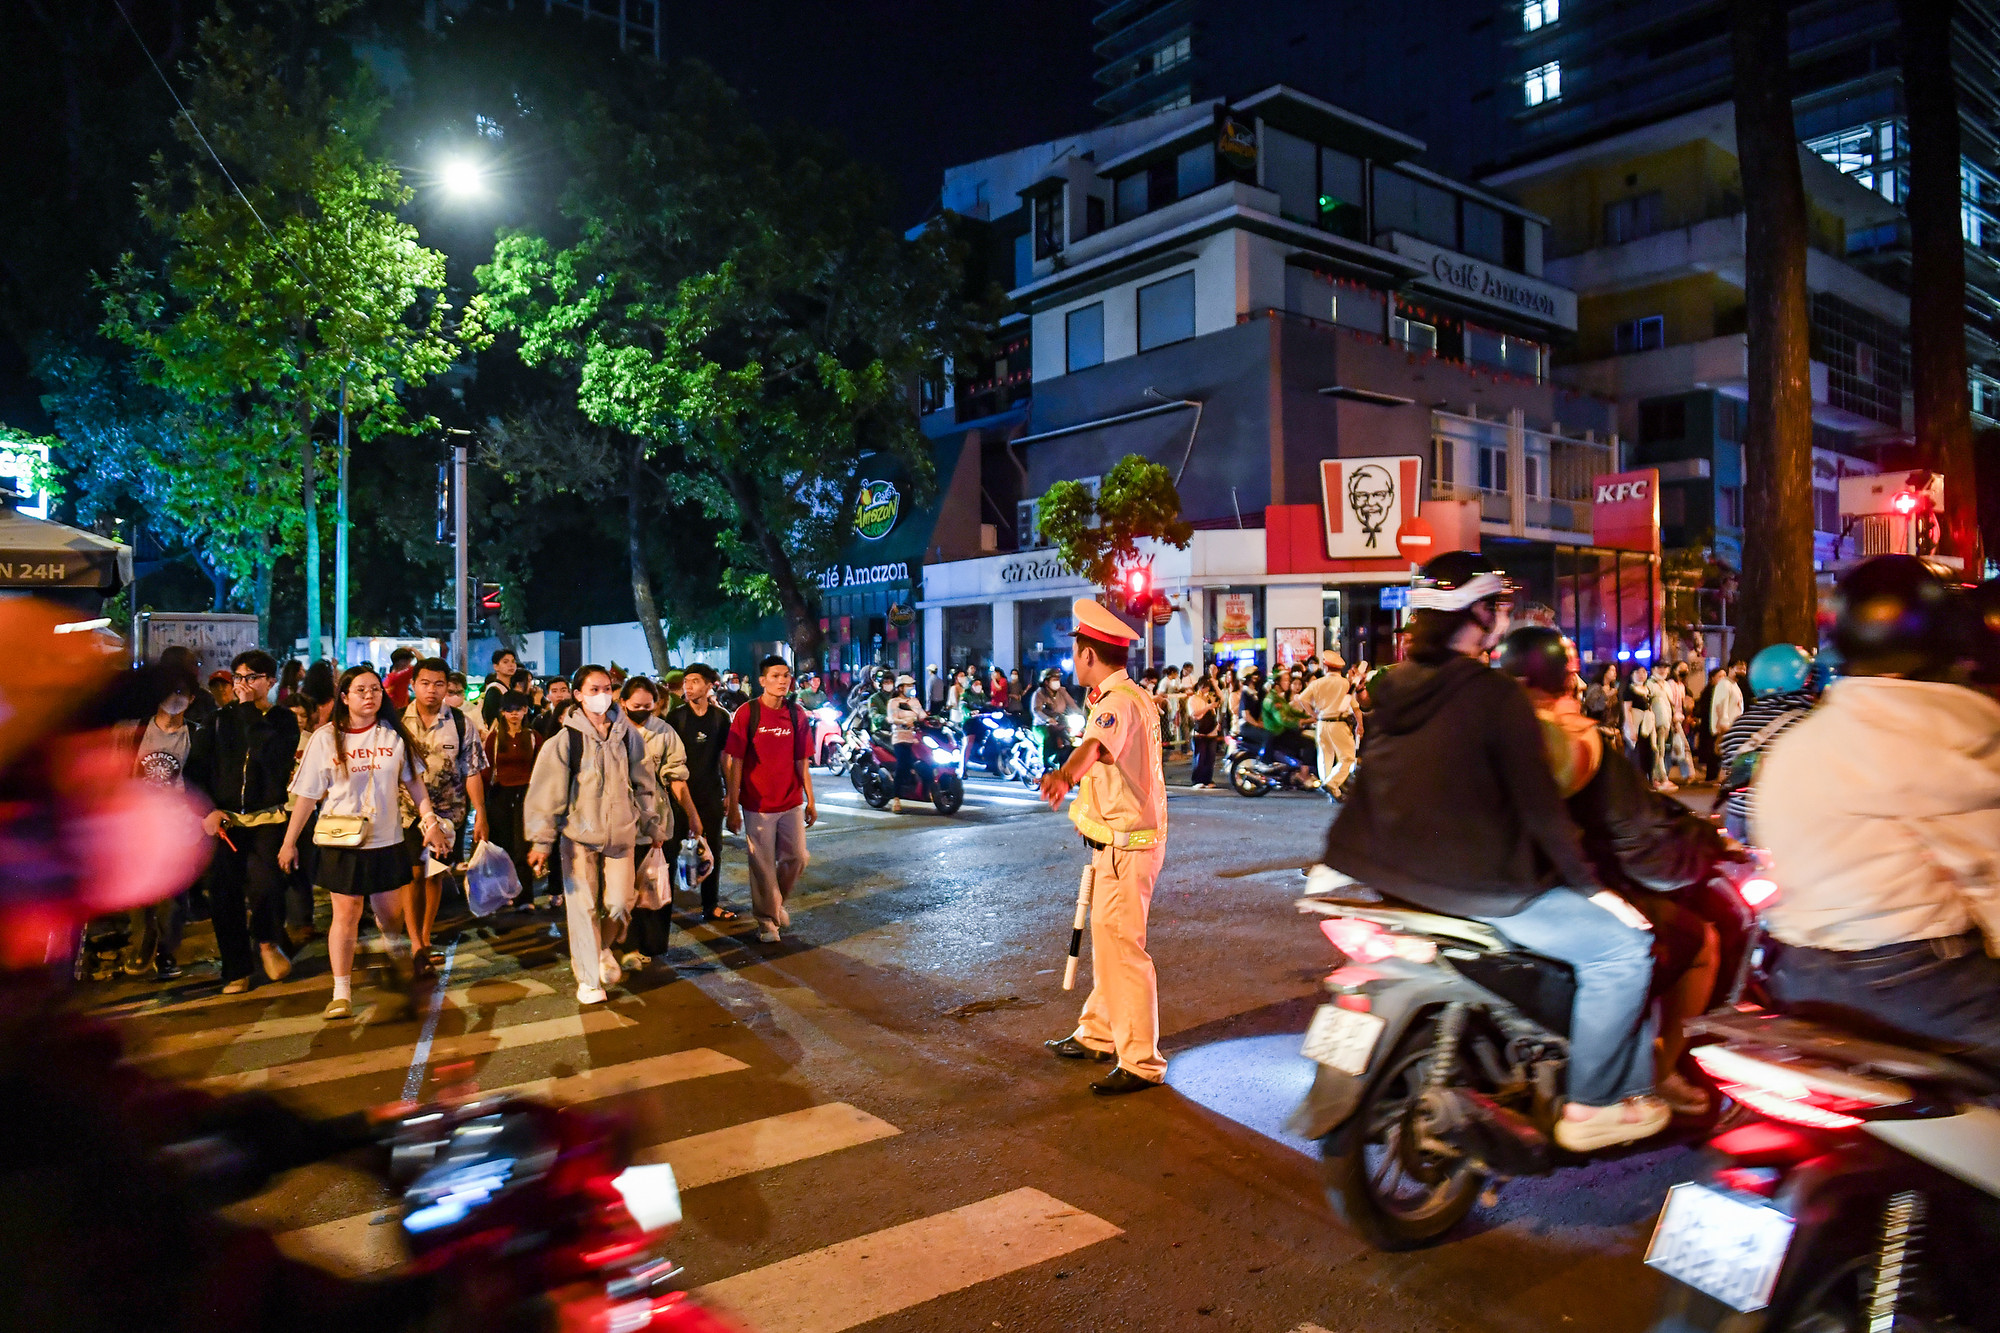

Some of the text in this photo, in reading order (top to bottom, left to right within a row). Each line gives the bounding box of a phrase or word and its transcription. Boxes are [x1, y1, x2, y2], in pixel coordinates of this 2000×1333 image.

[1432, 254, 1554, 316] Café Amazon
[1596, 480, 1649, 504] KFC
[19, 563, 66, 580] 24H
[843, 562, 909, 586] Amazon
[1026, 559, 1061, 581] Rán
[332, 747, 394, 767] LVENTS
[351, 763, 382, 773] GLOBAL
